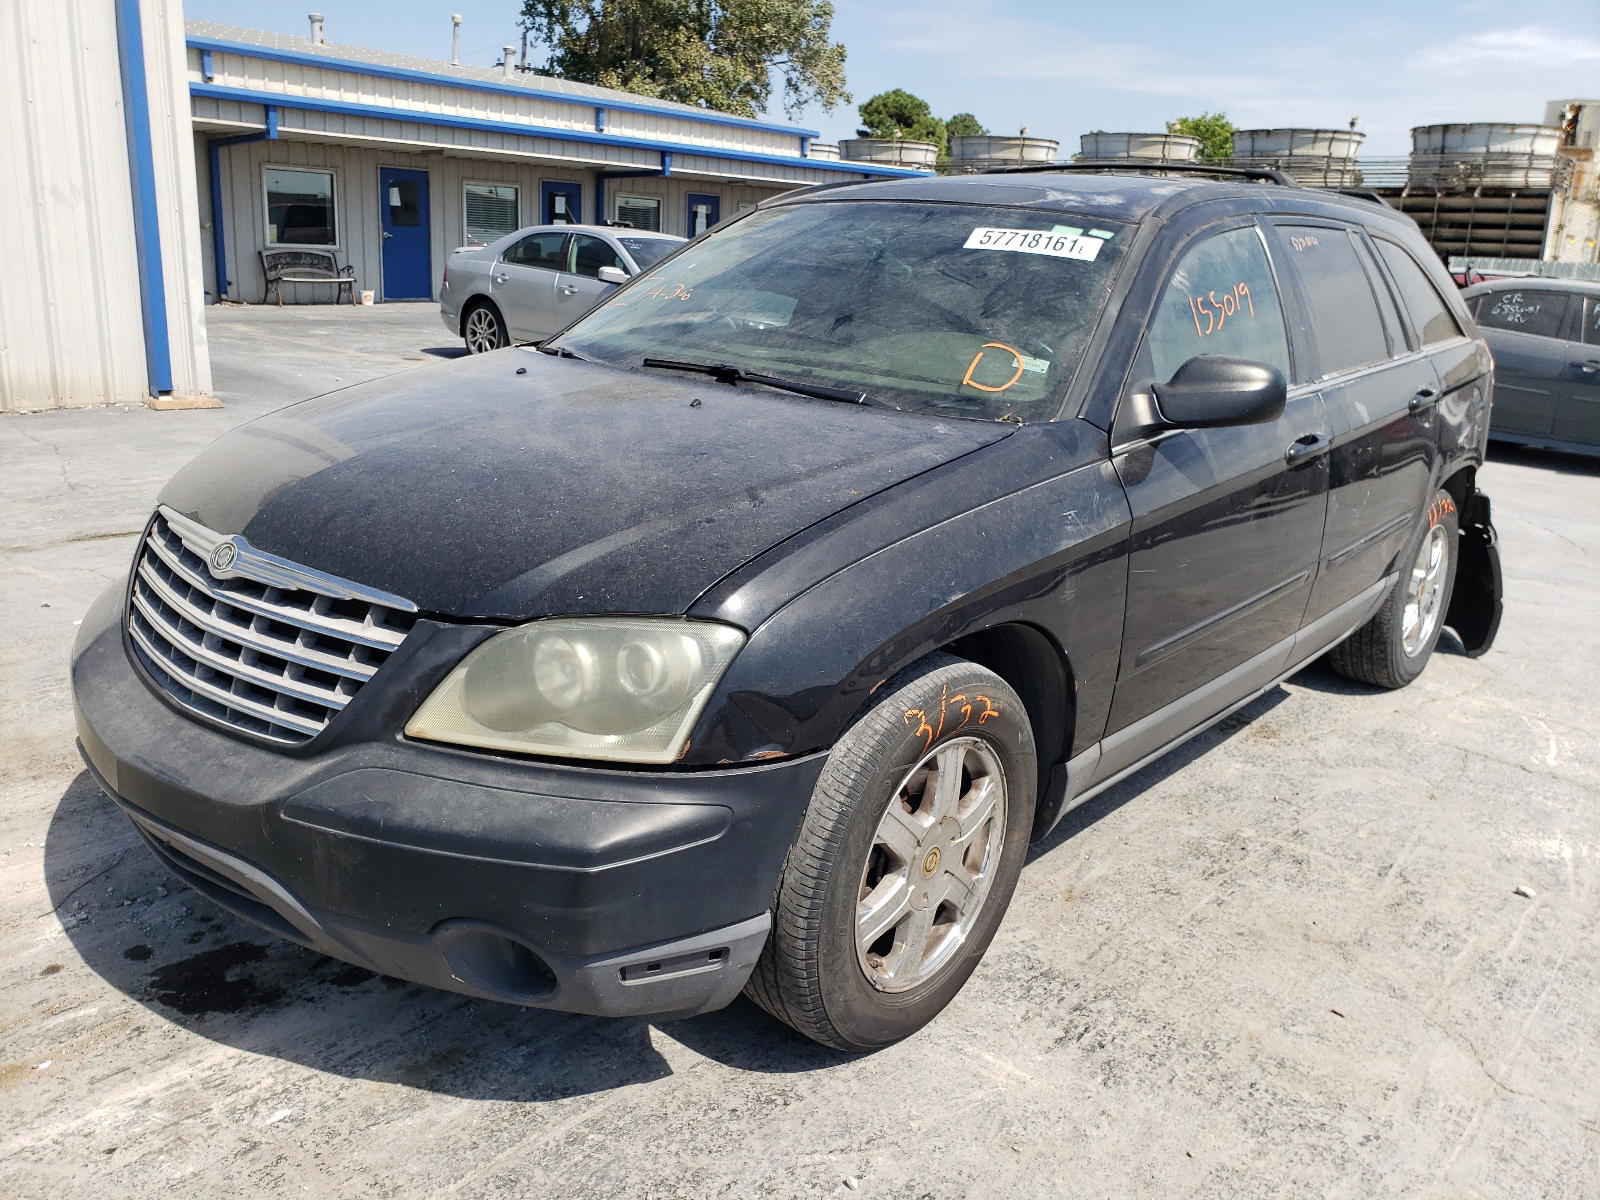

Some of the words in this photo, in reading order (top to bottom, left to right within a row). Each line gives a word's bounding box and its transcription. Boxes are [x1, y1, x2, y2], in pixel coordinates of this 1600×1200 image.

[979, 230, 1079, 254] 57718161
[1188, 282, 1254, 337] 155019
[903, 683, 999, 758] 3/32
